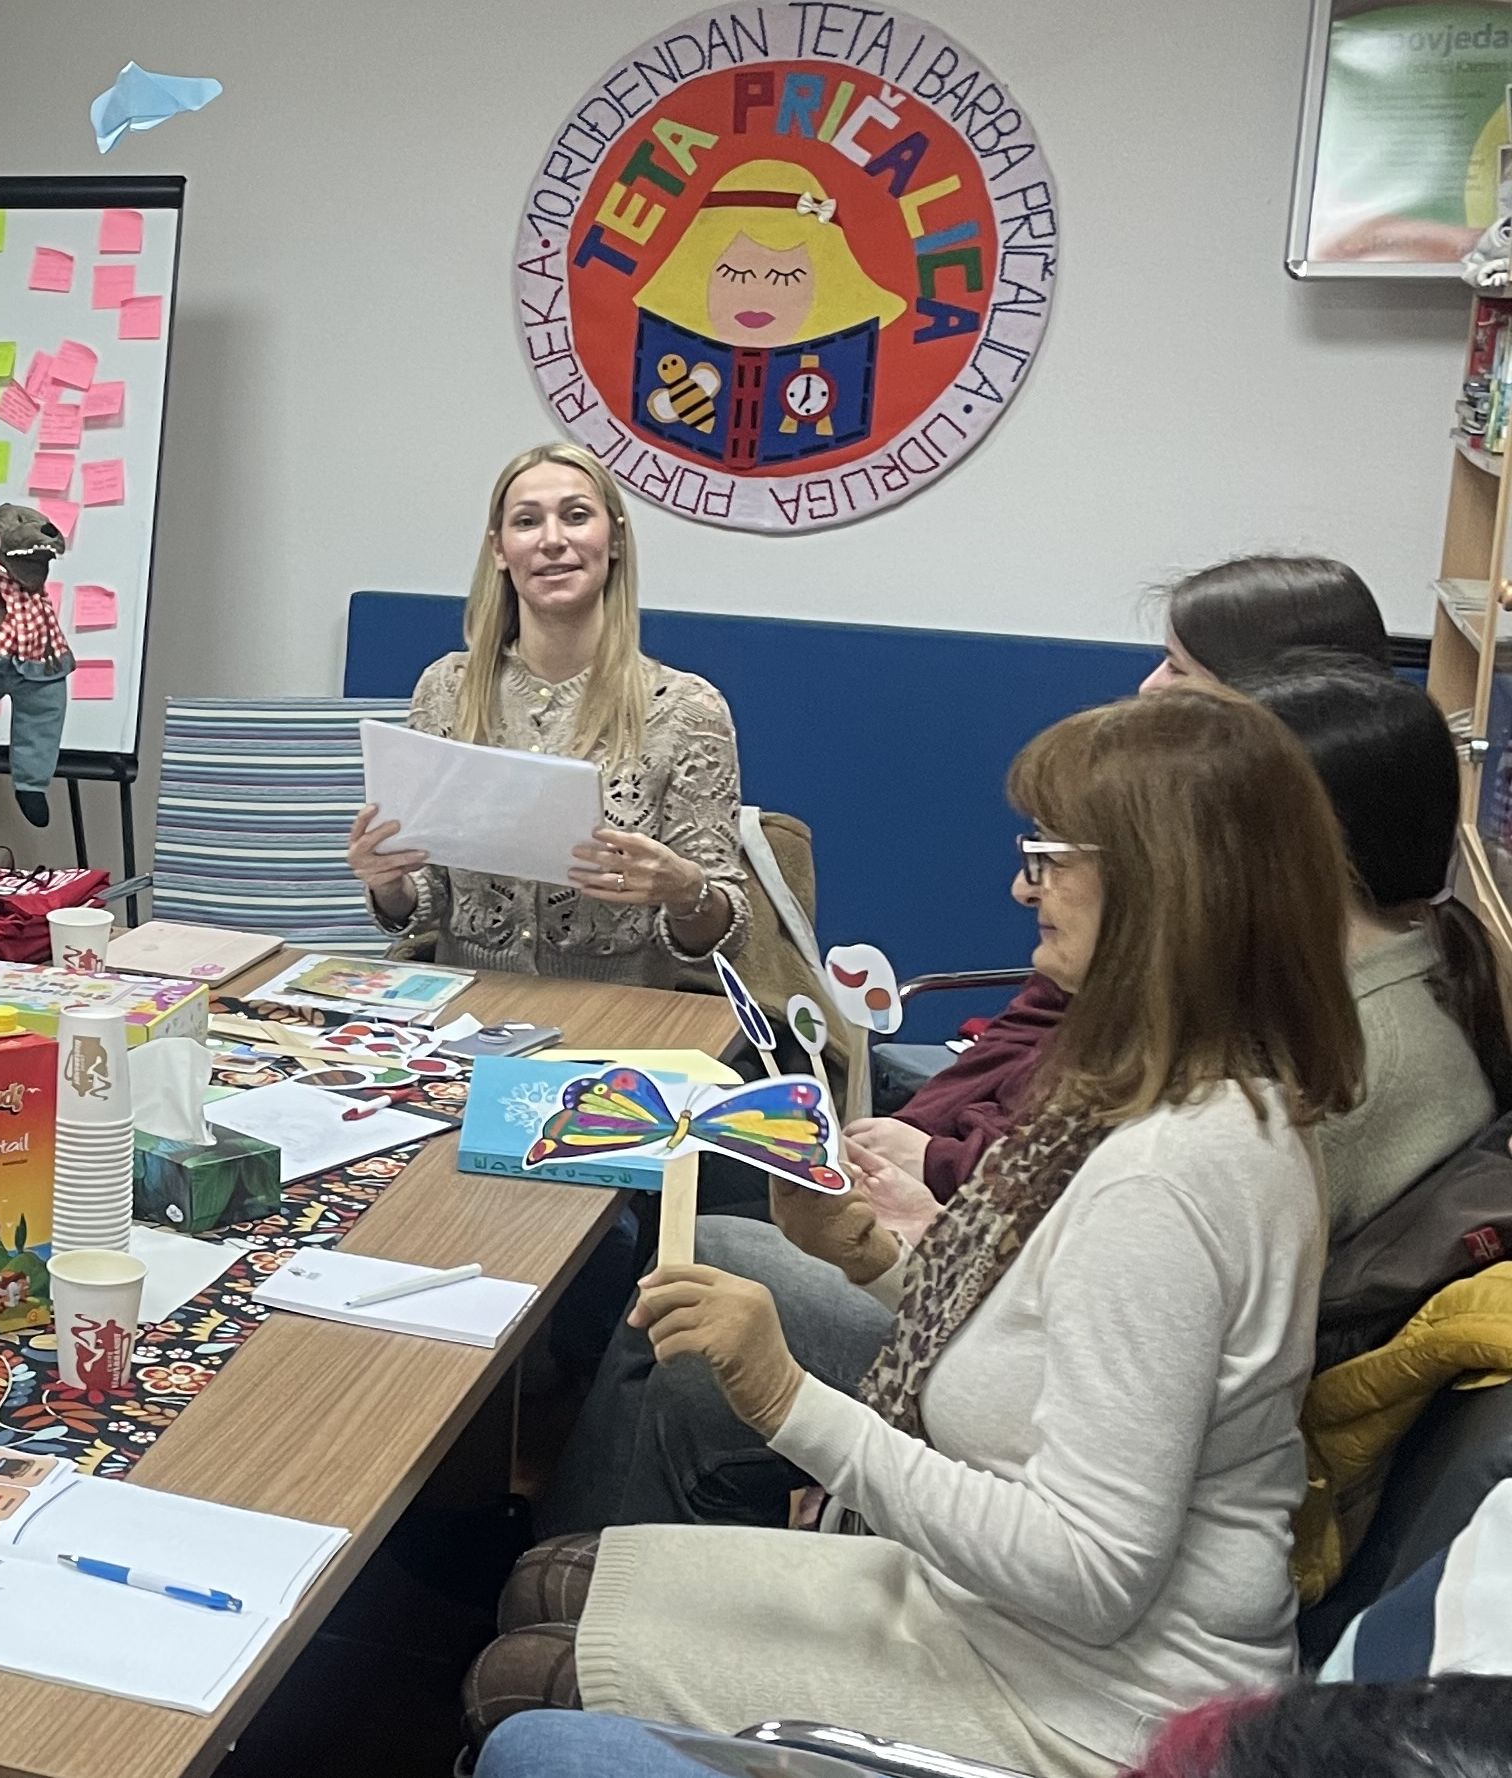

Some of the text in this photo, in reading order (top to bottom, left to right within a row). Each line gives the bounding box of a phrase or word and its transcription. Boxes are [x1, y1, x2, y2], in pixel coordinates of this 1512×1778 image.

[788, 2, 894, 76] TETA
[895, 34, 925, 83] I
[912, 46, 1035, 181] BARBA
[573, 71, 983, 345] TETA PRIČALICA
[518, 250, 599, 424] RIJEKA
[954, 181, 1057, 403] PRIČALICA
[769, 412, 967, 525] UDRUGA
